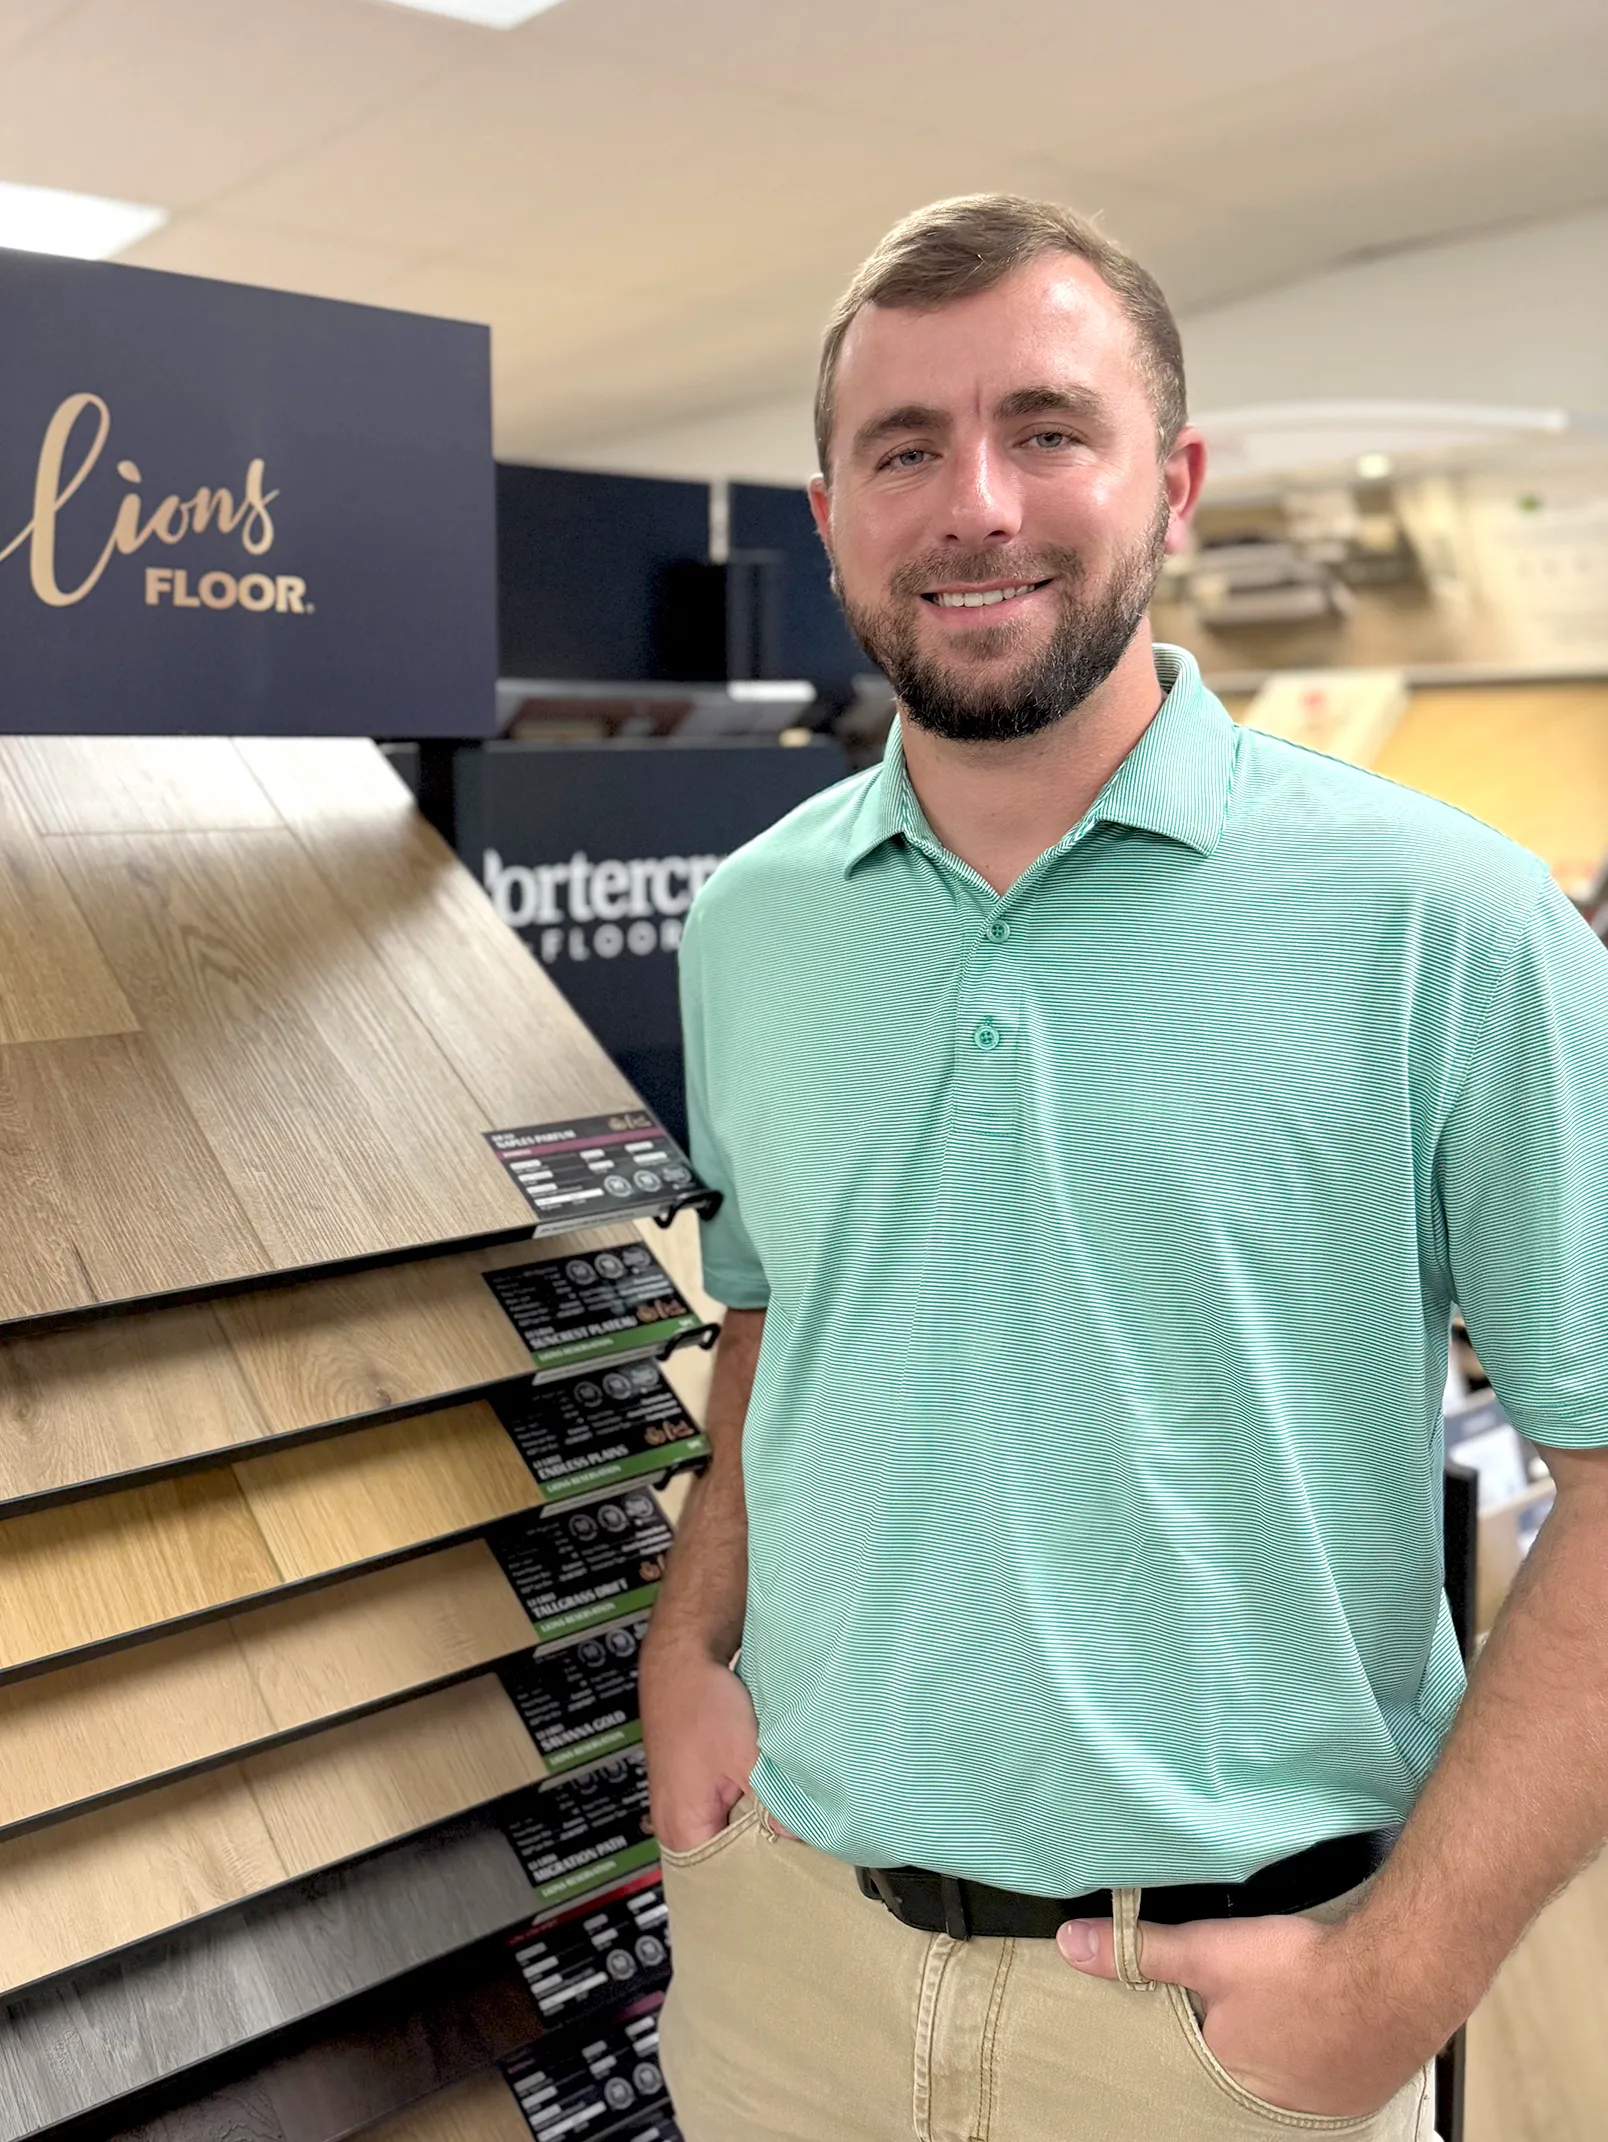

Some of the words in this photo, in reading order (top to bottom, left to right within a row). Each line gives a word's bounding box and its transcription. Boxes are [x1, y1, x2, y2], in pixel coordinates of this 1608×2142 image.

[537, 1455, 588, 1480] ENDLESS
[588, 1444, 629, 1465] PLAINS
[531, 1589, 595, 1619] TALLGRASS
[593, 1710, 627, 1731] GOLD
[532, 1845, 598, 1883] MIGRATION
[598, 1835, 628, 1855] PATH
